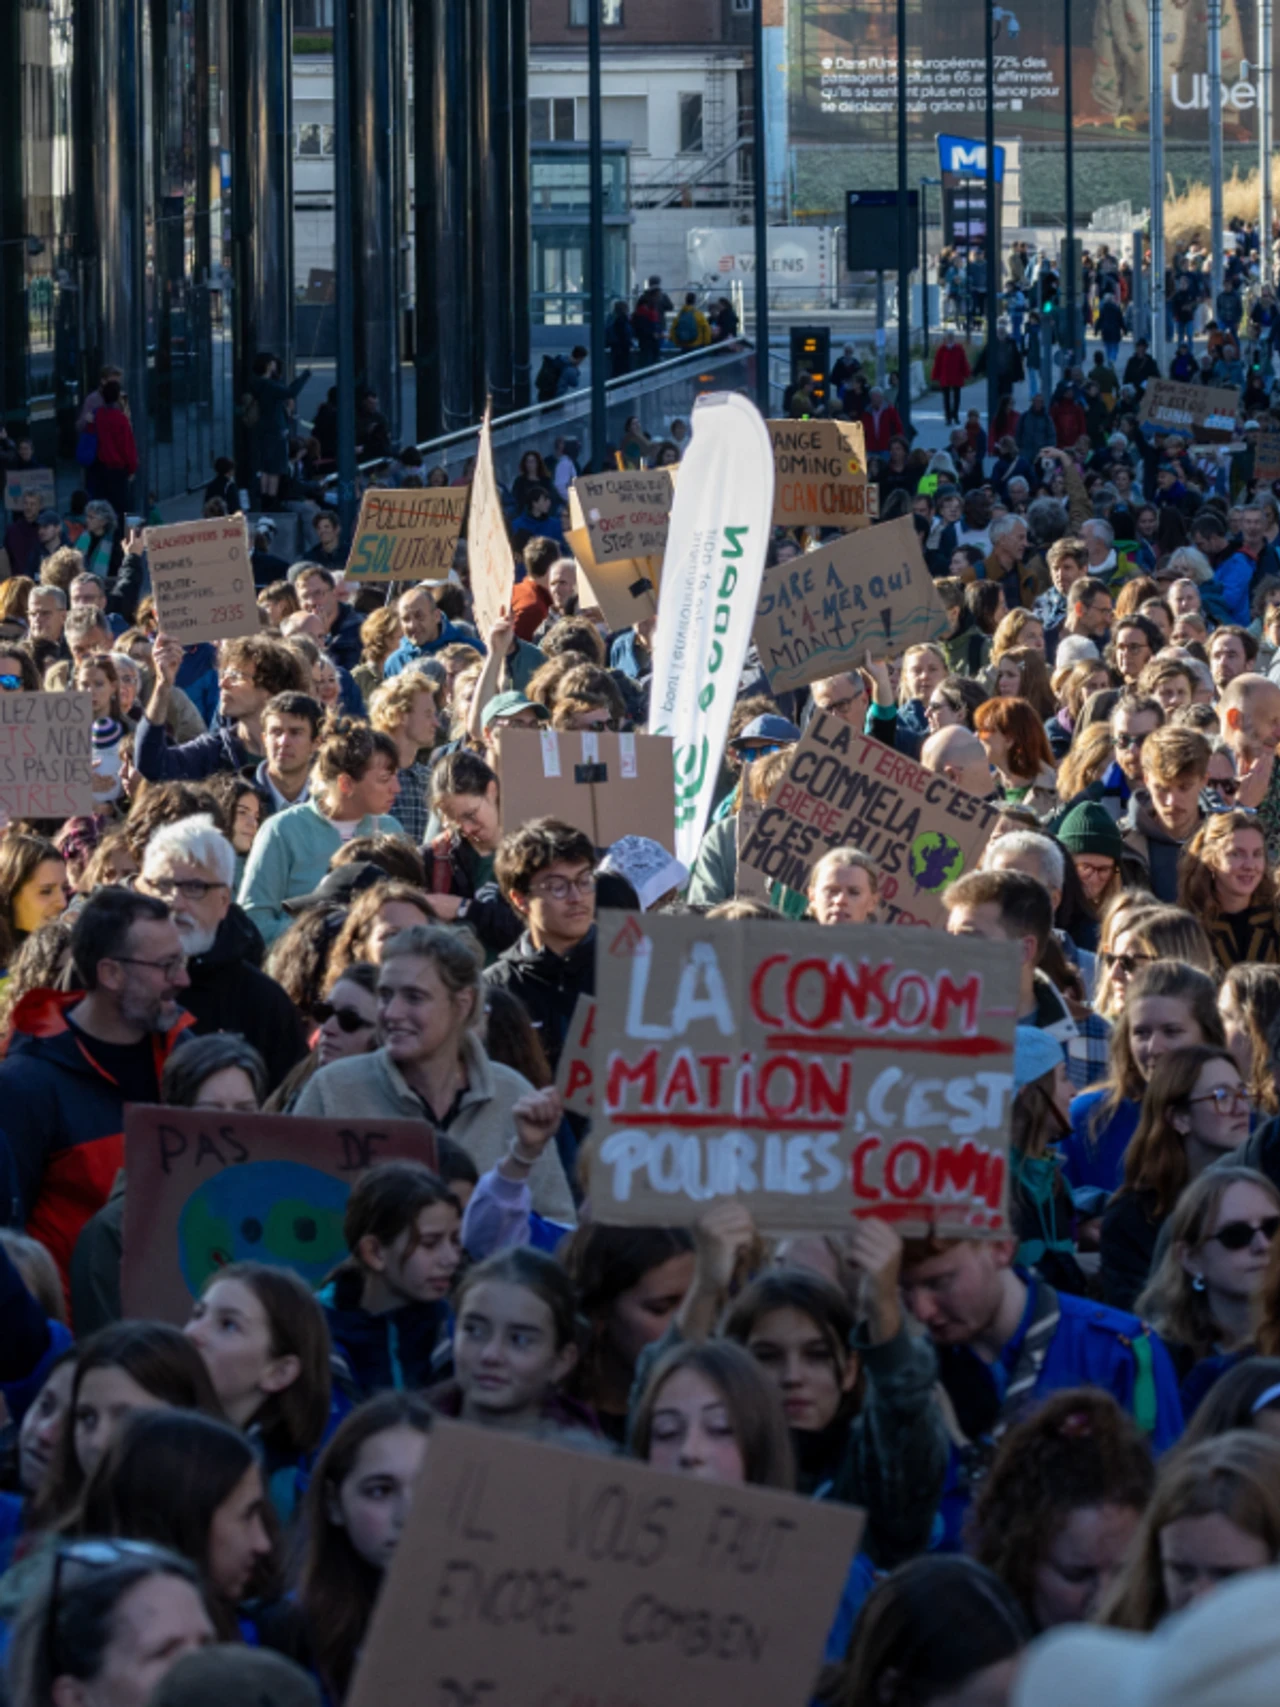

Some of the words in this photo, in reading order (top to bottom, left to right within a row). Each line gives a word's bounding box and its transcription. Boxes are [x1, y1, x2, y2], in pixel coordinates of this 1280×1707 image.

[835, 56, 867, 70] Dans
[993, 56, 1020, 70] 72%
[1022, 55, 1047, 70] des
[821, 71, 885, 87] passagers
[934, 70, 952, 84] de
[953, 70, 972, 84] 65
[996, 70, 1053, 84] affirment
[854, 87, 869, 97] se
[872, 85, 919, 98] sentnt
[920, 85, 946, 100] plus
[948, 87, 965, 97] en
[1030, 86, 1060, 100] pour
[820, 101, 836, 113] se
[838, 99, 895, 115] déplacer
[929, 99, 966, 115] grâce
[977, 99, 1010, 112] Uer
[951, 145, 988, 171] M
[773, 430, 823, 452] ANGE
[837, 434, 852, 453] IS
[774, 454, 843, 477] OMING
[780, 481, 818, 513] CAN
[826, 561, 844, 591] A
[44, 696, 85, 724] VOS
[23, 755, 60, 783] PAS
[812, 714, 851, 755] LA
[857, 734, 932, 795] TERRE
[924, 778, 1000, 830] C'EST
[840, 817, 907, 875] PLUS
[739, 831, 814, 894] MOIN
[625, 935, 736, 1041] LA
[157, 1124, 250, 1176] PAS
[564, 1481, 675, 1568] VOUS
[703, 1504, 798, 1575] FAUT
[429, 1558, 591, 1636] ENCORE
